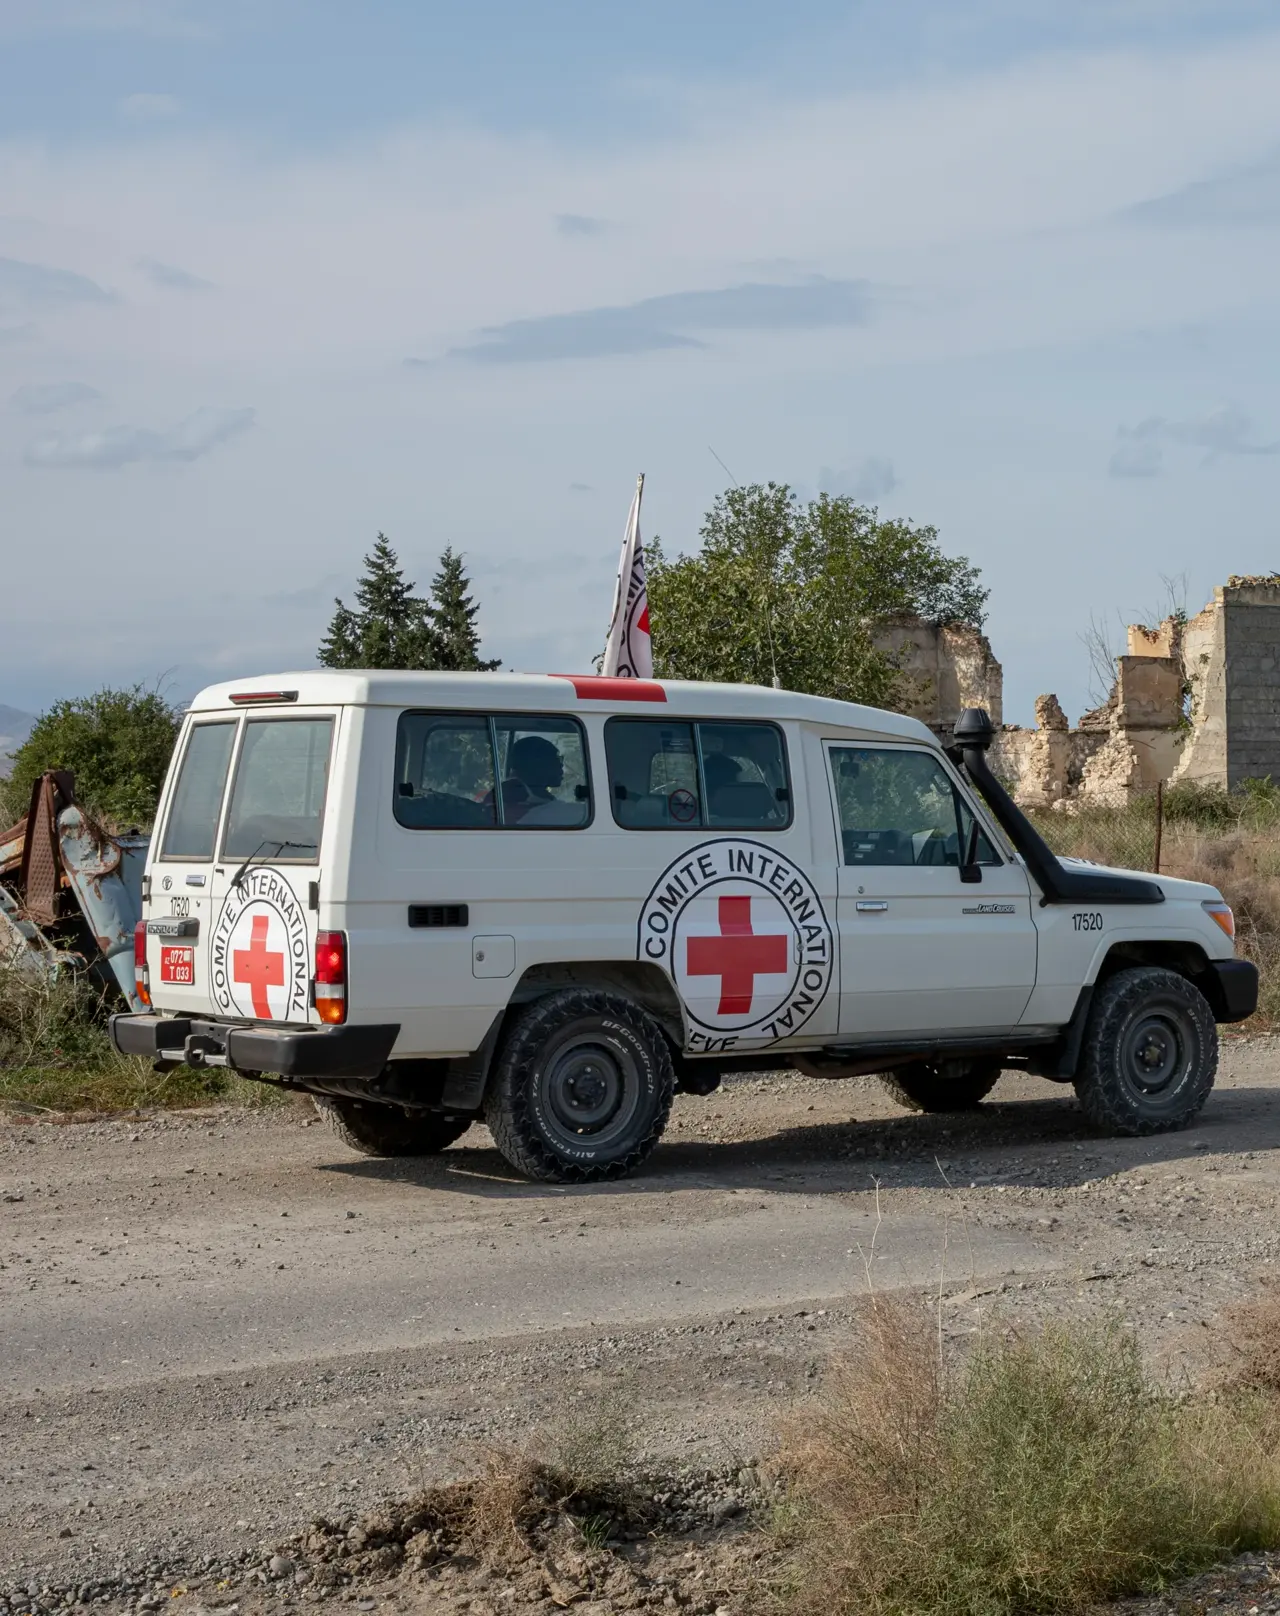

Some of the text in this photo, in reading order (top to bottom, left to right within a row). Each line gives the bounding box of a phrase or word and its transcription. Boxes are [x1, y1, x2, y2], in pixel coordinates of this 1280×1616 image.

[170, 897, 190, 917] 17520
[1071, 912, 1103, 931] 17520
[214, 875, 306, 1012] COMITE INTERNATIONAL
[645, 849, 826, 1038] COMITE INTERNATIONAL
[170, 950, 184, 964] 072
[169, 966, 189, 980] T 033
